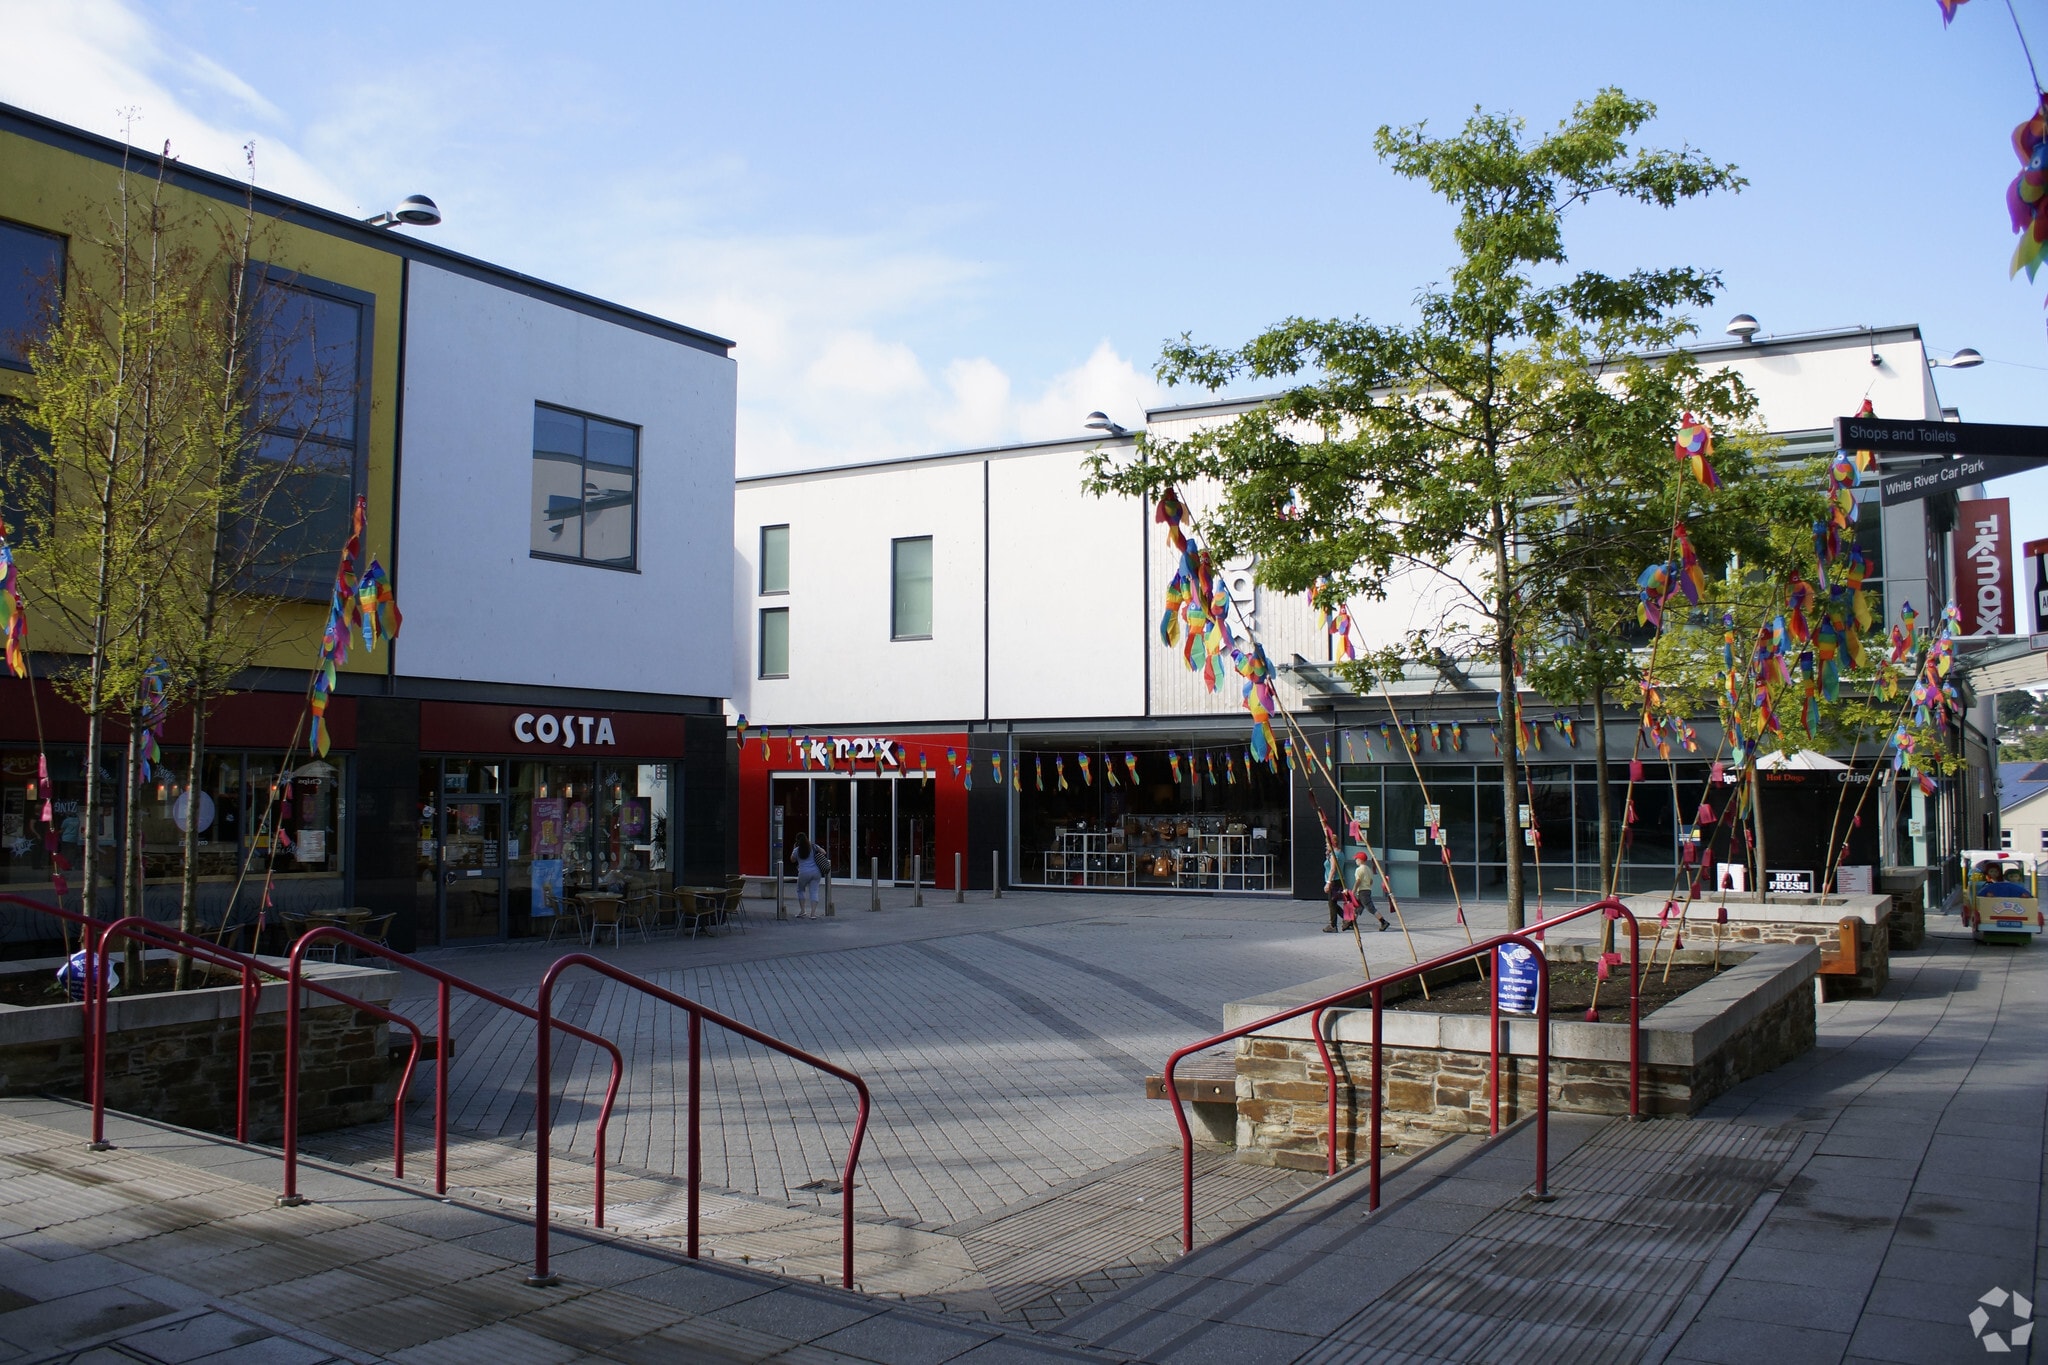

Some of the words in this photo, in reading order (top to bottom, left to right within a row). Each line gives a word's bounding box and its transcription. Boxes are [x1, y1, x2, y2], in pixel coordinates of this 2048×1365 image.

[1850, 426, 1888, 441] Shops
[1892, 429, 1914, 441] and
[1917, 429, 1956, 442] Toilets
[1886, 480, 1911, 495] White
[1914, 473, 1938, 488] River
[1940, 467, 1958, 480] Car
[1961, 459, 1985, 476] Park
[514, 713, 616, 748] COSTA
[1766, 773, 1782, 781] Hot
[1784, 774, 1805, 783] Dogs
[1837, 772, 1870, 784] Chips
[1775, 873, 1800, 882] HOT
[1769, 881, 1809, 890] FRESH
